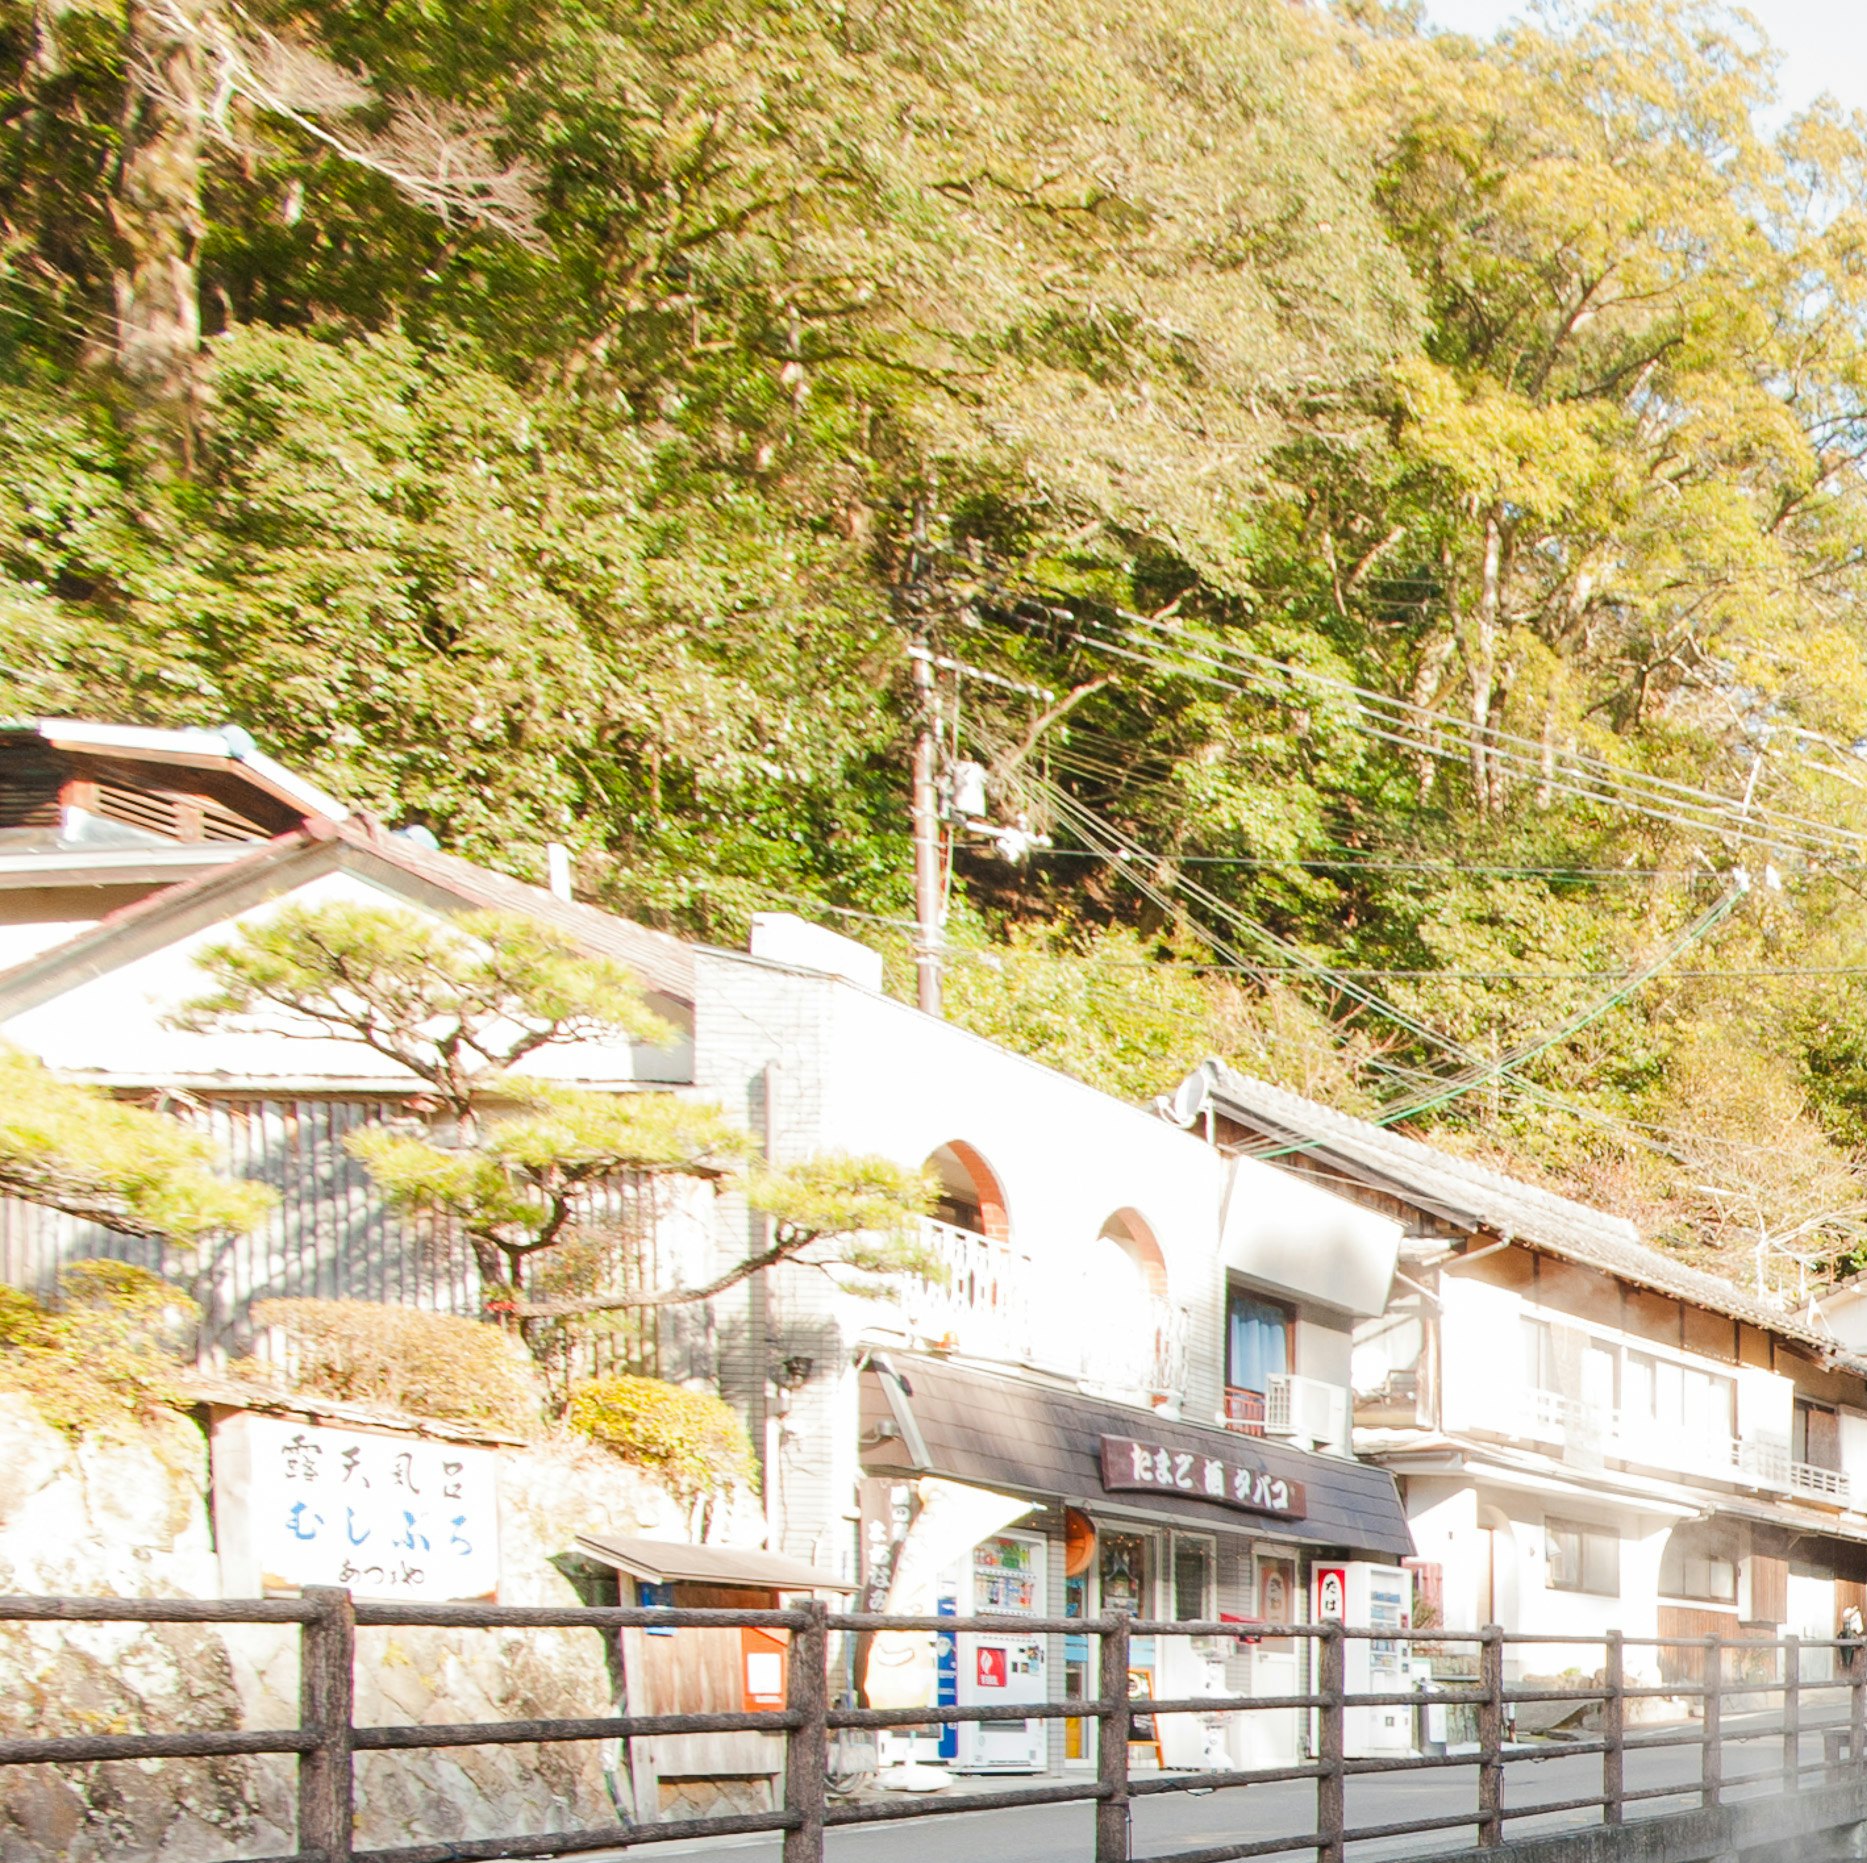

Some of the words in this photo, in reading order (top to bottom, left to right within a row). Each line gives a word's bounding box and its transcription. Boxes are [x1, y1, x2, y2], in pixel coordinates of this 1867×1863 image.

[281, 1434, 464, 1499] 露天風呂
[285, 1501, 473, 1556] むしぶろ
